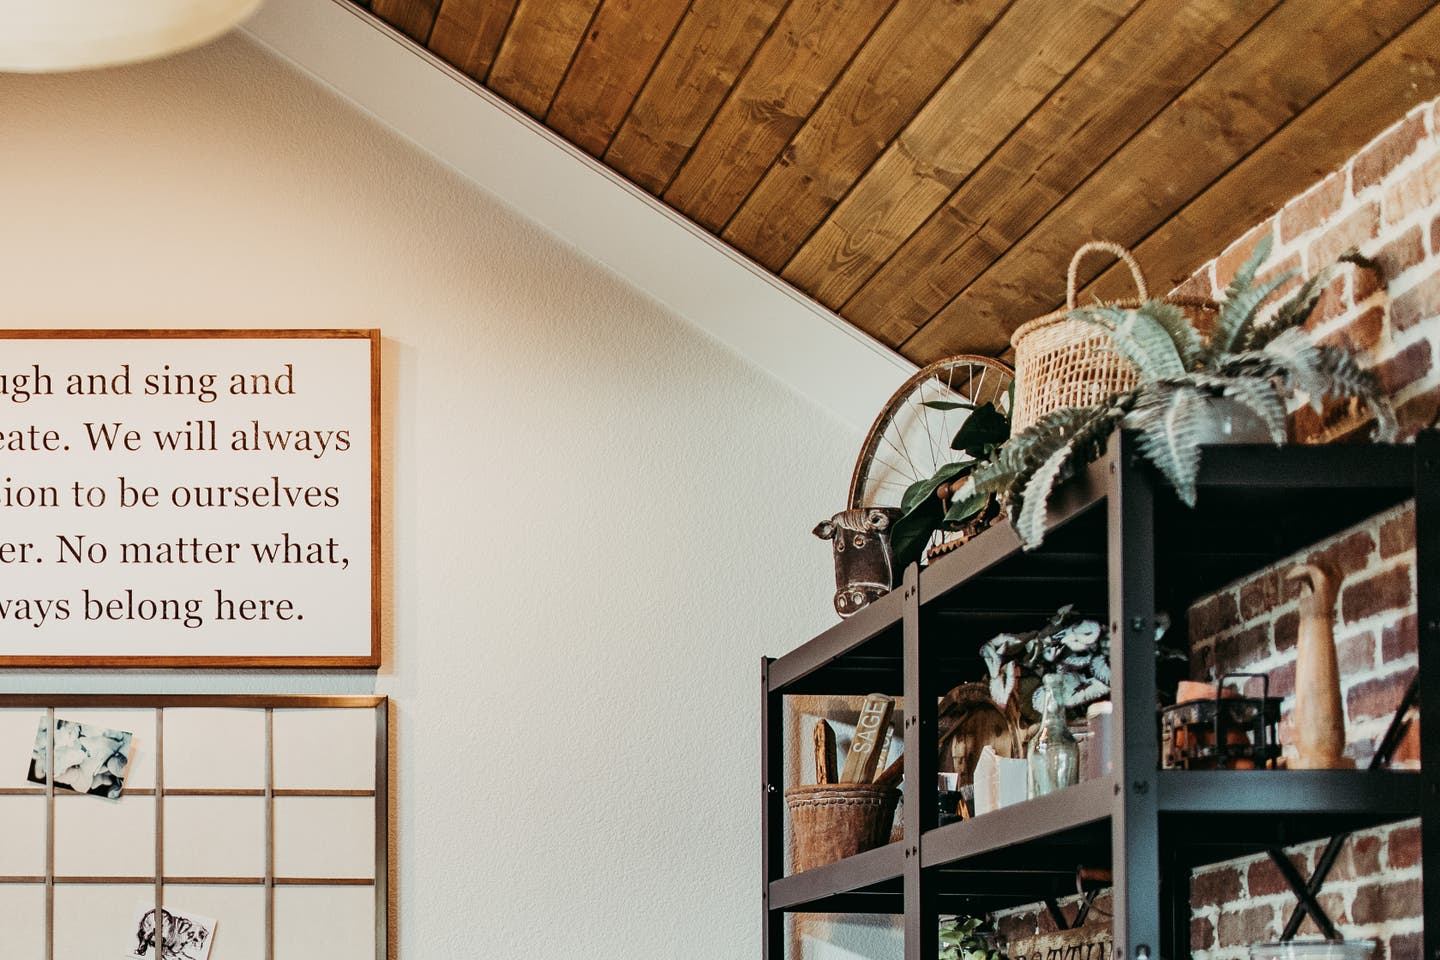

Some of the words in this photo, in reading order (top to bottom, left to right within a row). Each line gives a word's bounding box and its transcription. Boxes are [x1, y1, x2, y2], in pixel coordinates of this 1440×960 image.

[66, 364, 133, 396] and
[144, 364, 218, 404] sing
[229, 363, 296, 395] and
[82, 422, 141, 452] We
[152, 419, 219, 451] will
[230, 419, 351, 460] always
[71, 481, 106, 508] to
[117, 476, 159, 508] be
[171, 476, 340, 508] ourselves
[55, 534, 107, 564] No
[119, 537, 241, 564] matter
[250, 532, 349, 571] what,
[81, 588, 203, 629] belong
[213, 588, 304, 621] here.
[853, 702, 887, 754] SAGE
